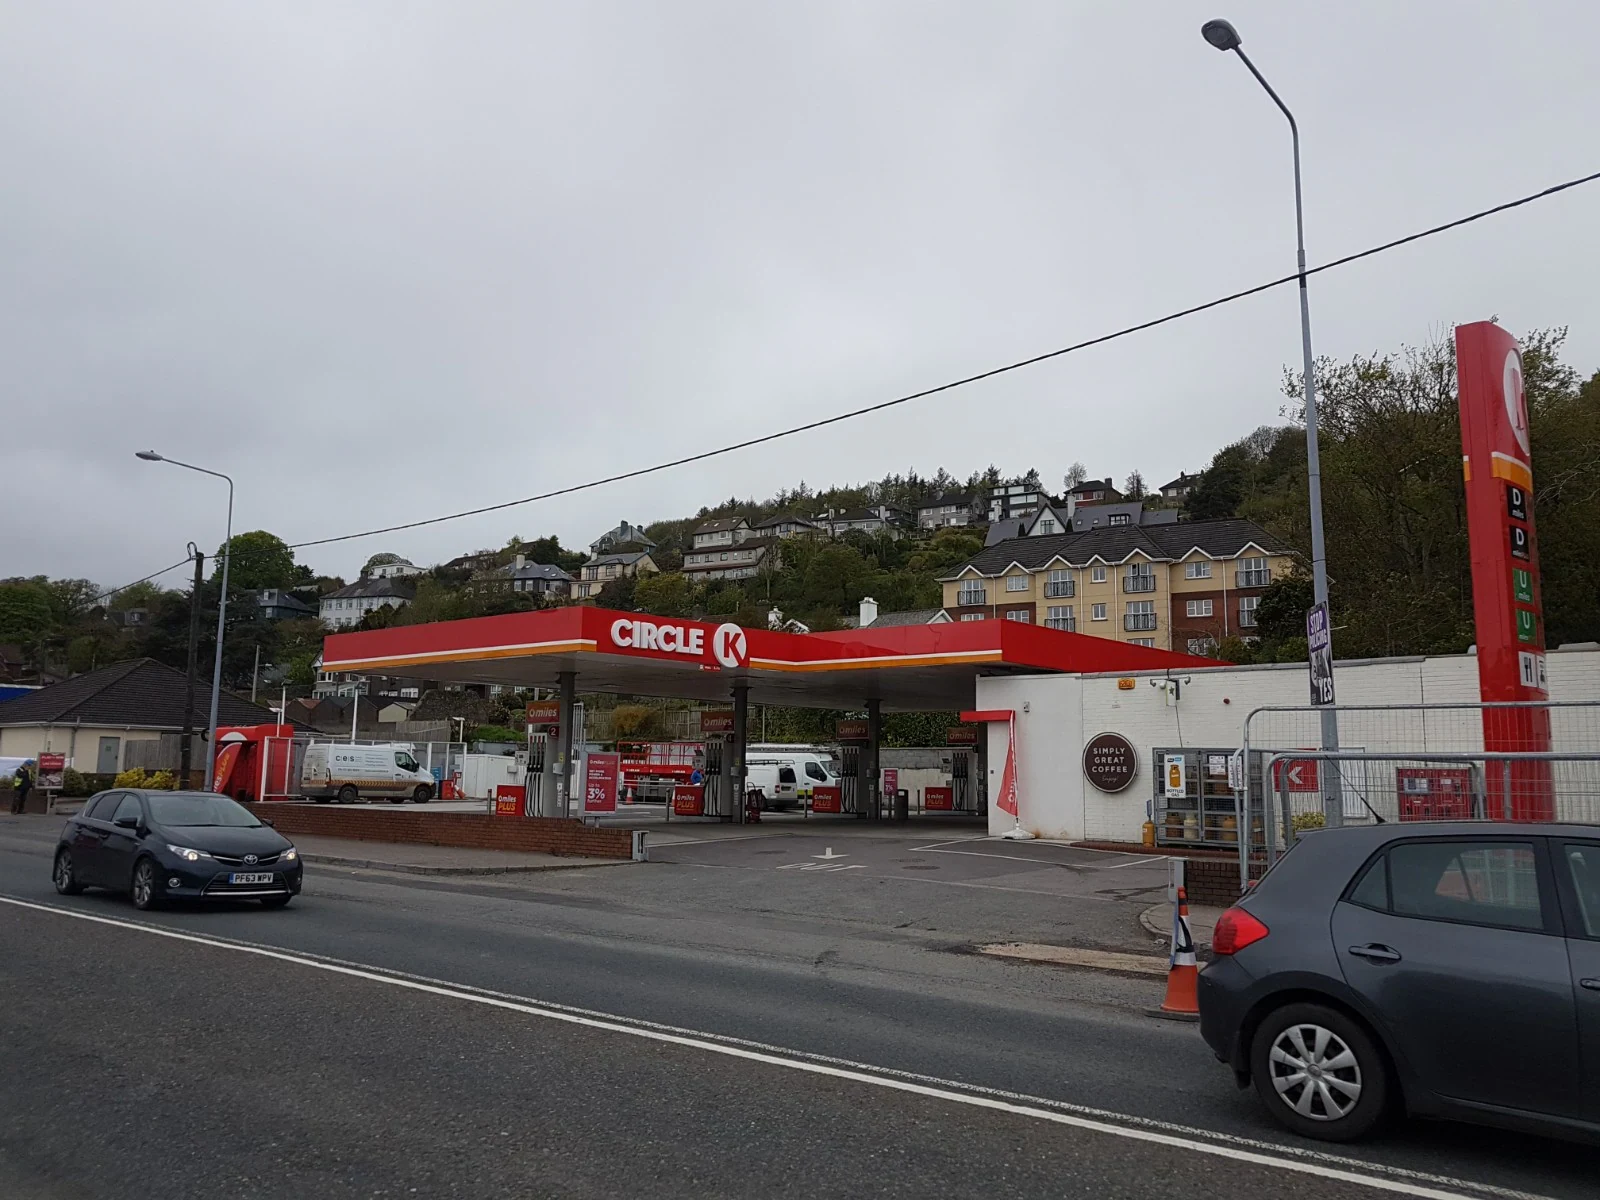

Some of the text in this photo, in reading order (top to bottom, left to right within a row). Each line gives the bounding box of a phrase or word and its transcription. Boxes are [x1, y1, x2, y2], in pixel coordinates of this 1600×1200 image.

[1512, 487, 1521, 506] D
[1515, 527, 1525, 546] D
[1522, 611, 1530, 629] U
[611, 618, 704, 655] CIRCLE
[1318, 675, 1333, 702] YES
[550, 727, 557, 736] 2
[1093, 747, 1125, 755] SIMPLY
[1094, 756, 1125, 764] GREAT
[587, 788, 605, 799] 3%
[498, 802, 516, 811] PLUS
[676, 801, 694, 809] PLUS
[235, 874, 256, 883] PF63
